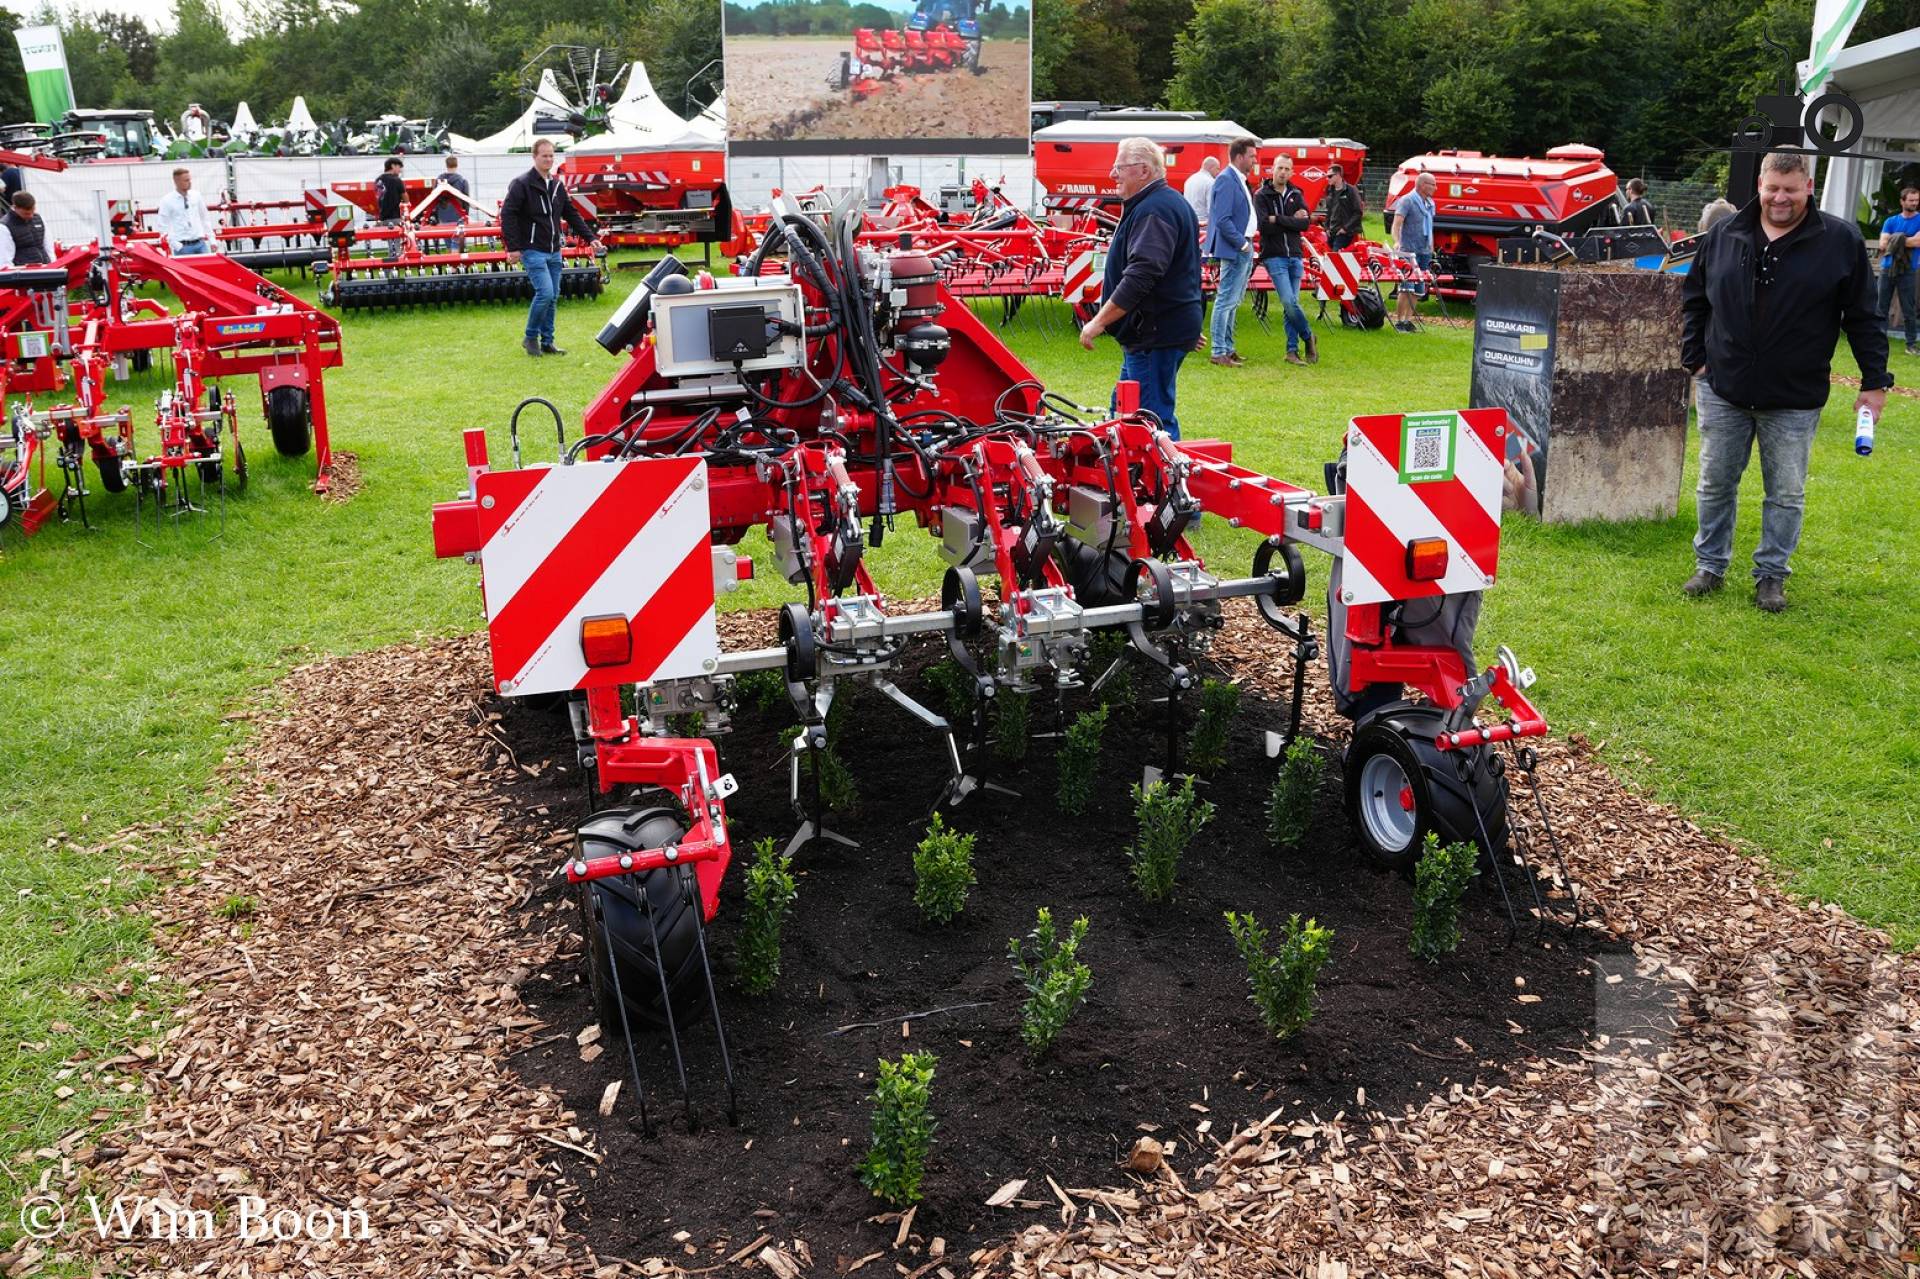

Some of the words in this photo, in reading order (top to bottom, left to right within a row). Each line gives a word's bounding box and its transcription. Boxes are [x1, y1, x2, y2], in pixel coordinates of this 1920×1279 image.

[1067, 184, 1096, 194] RAUCH
[1486, 320, 1536, 333] DURAKARB
[1484, 351, 1534, 366] DURAKUHN
